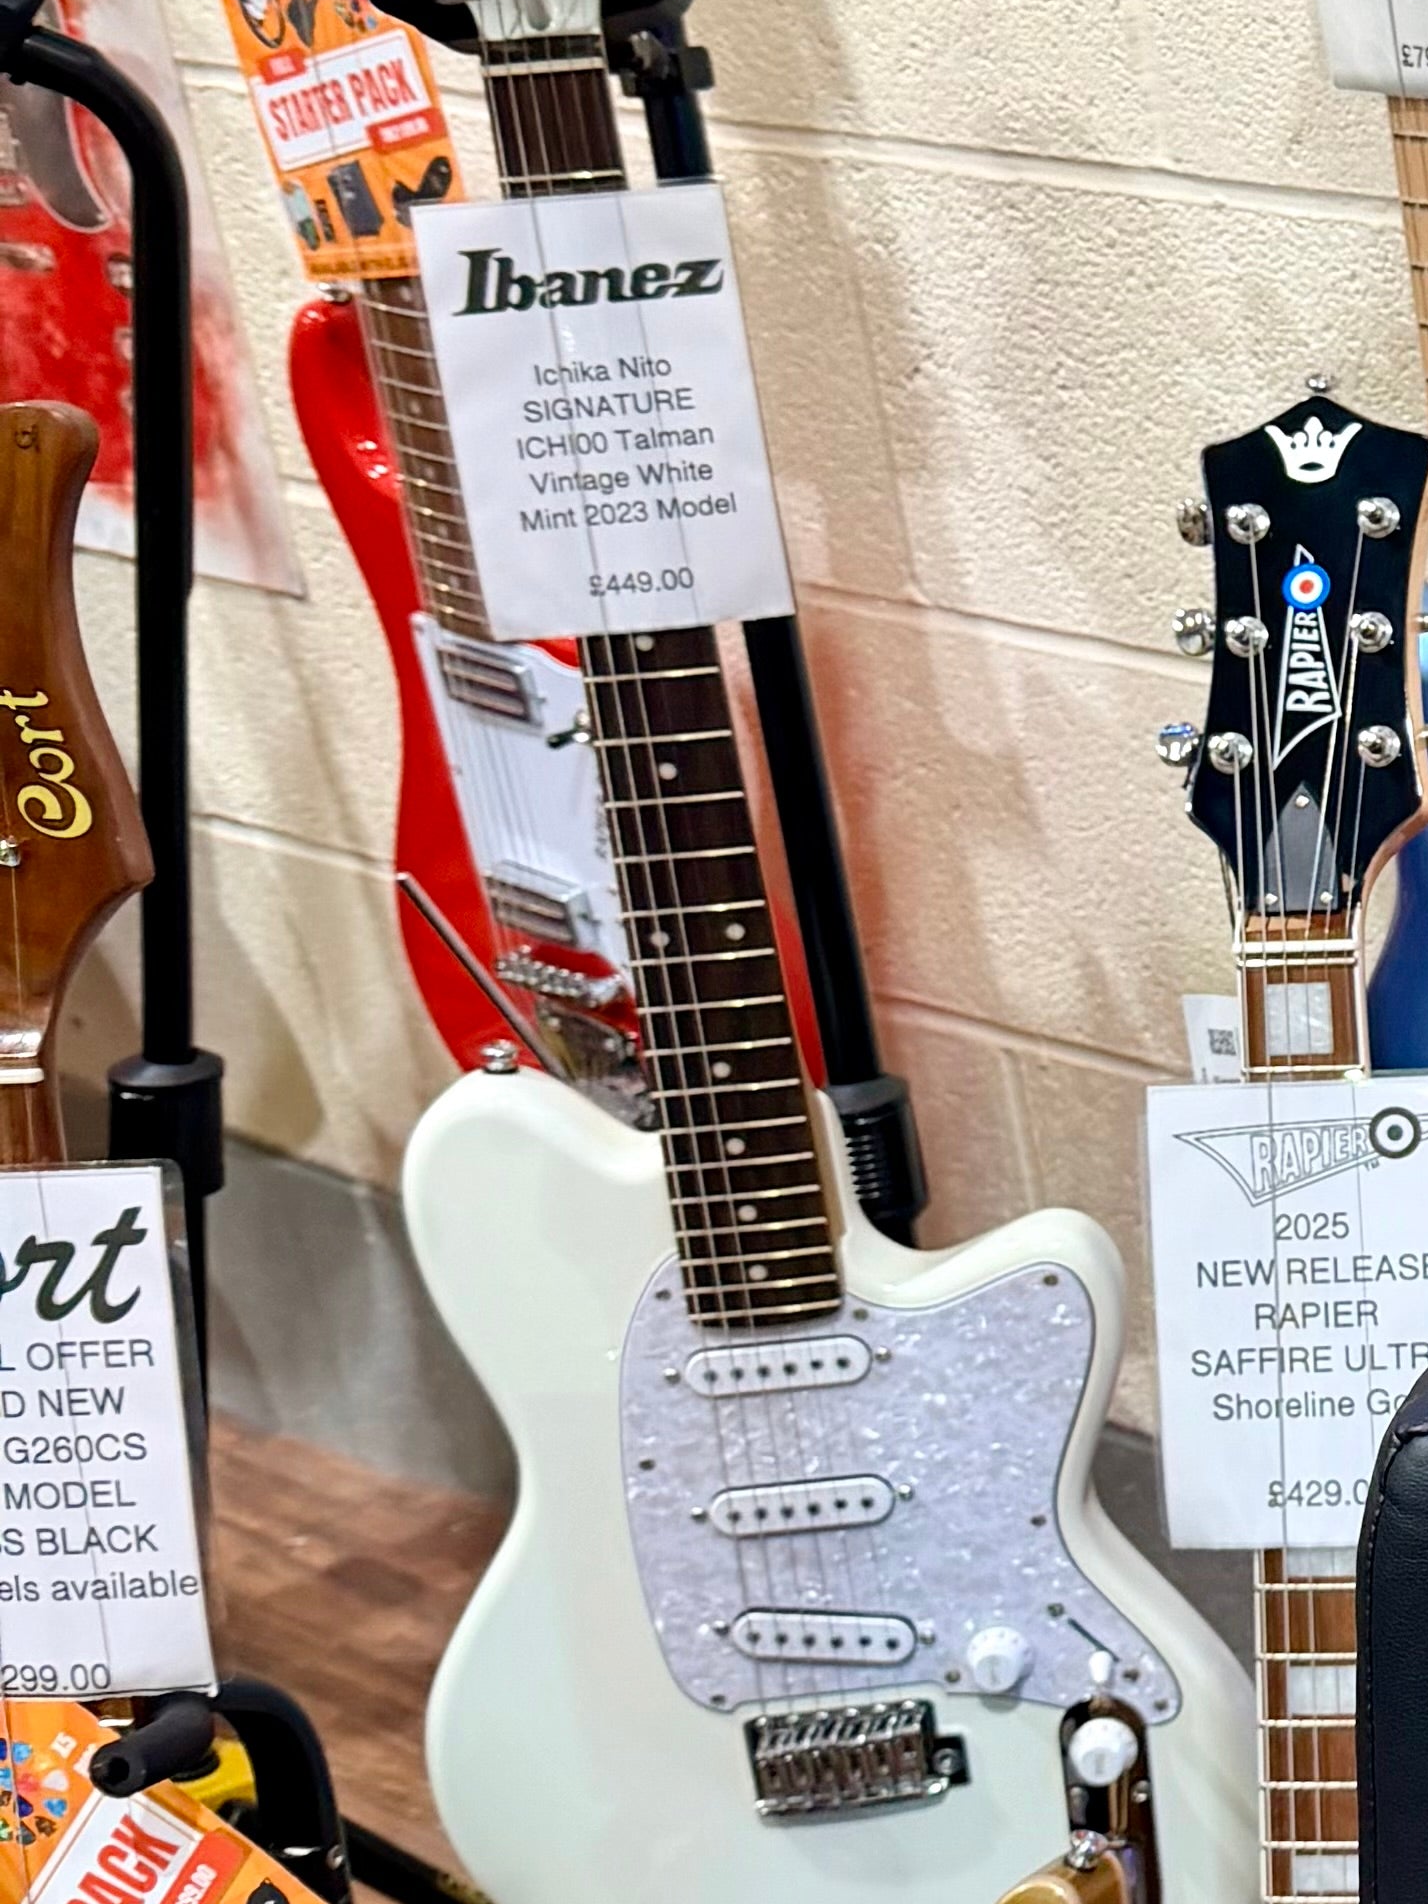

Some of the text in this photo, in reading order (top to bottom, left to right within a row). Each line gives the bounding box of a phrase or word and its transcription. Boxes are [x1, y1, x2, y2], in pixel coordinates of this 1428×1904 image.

[268, 80, 352, 142] STARTER
[349, 58, 418, 116] PACK
[452, 248, 724, 317] Ibanez
[534, 356, 672, 387] Ichika Nito
[523, 388, 695, 424] SIGNATURE
[614, 425, 714, 453] Talman
[529, 461, 713, 496] Vintage White
[520, 492, 737, 534] Mint 2023 Model
[589, 566, 694, 597] £449.00
[1285, 610, 1334, 714] RAPIER
[0, 689, 93, 839] Cort
[1250, 1126, 1371, 1193] RAPIER
[1275, 1212, 1350, 1241] 2025
[1197, 1258, 1275, 1288] NEW
[1255, 1301, 1378, 1330] RAPIER
[26, 1338, 155, 1371] OFFER
[1191, 1346, 1333, 1377] SAFFIRE
[38, 1387, 125, 1418] NEW
[1212, 1392, 1355, 1421] Shoreline
[4, 1432, 148, 1465] G260CS
[4, 1480, 136, 1510] MODEL
[37, 1524, 158, 1557] BLACK
[51, 1573, 200, 1601] available
